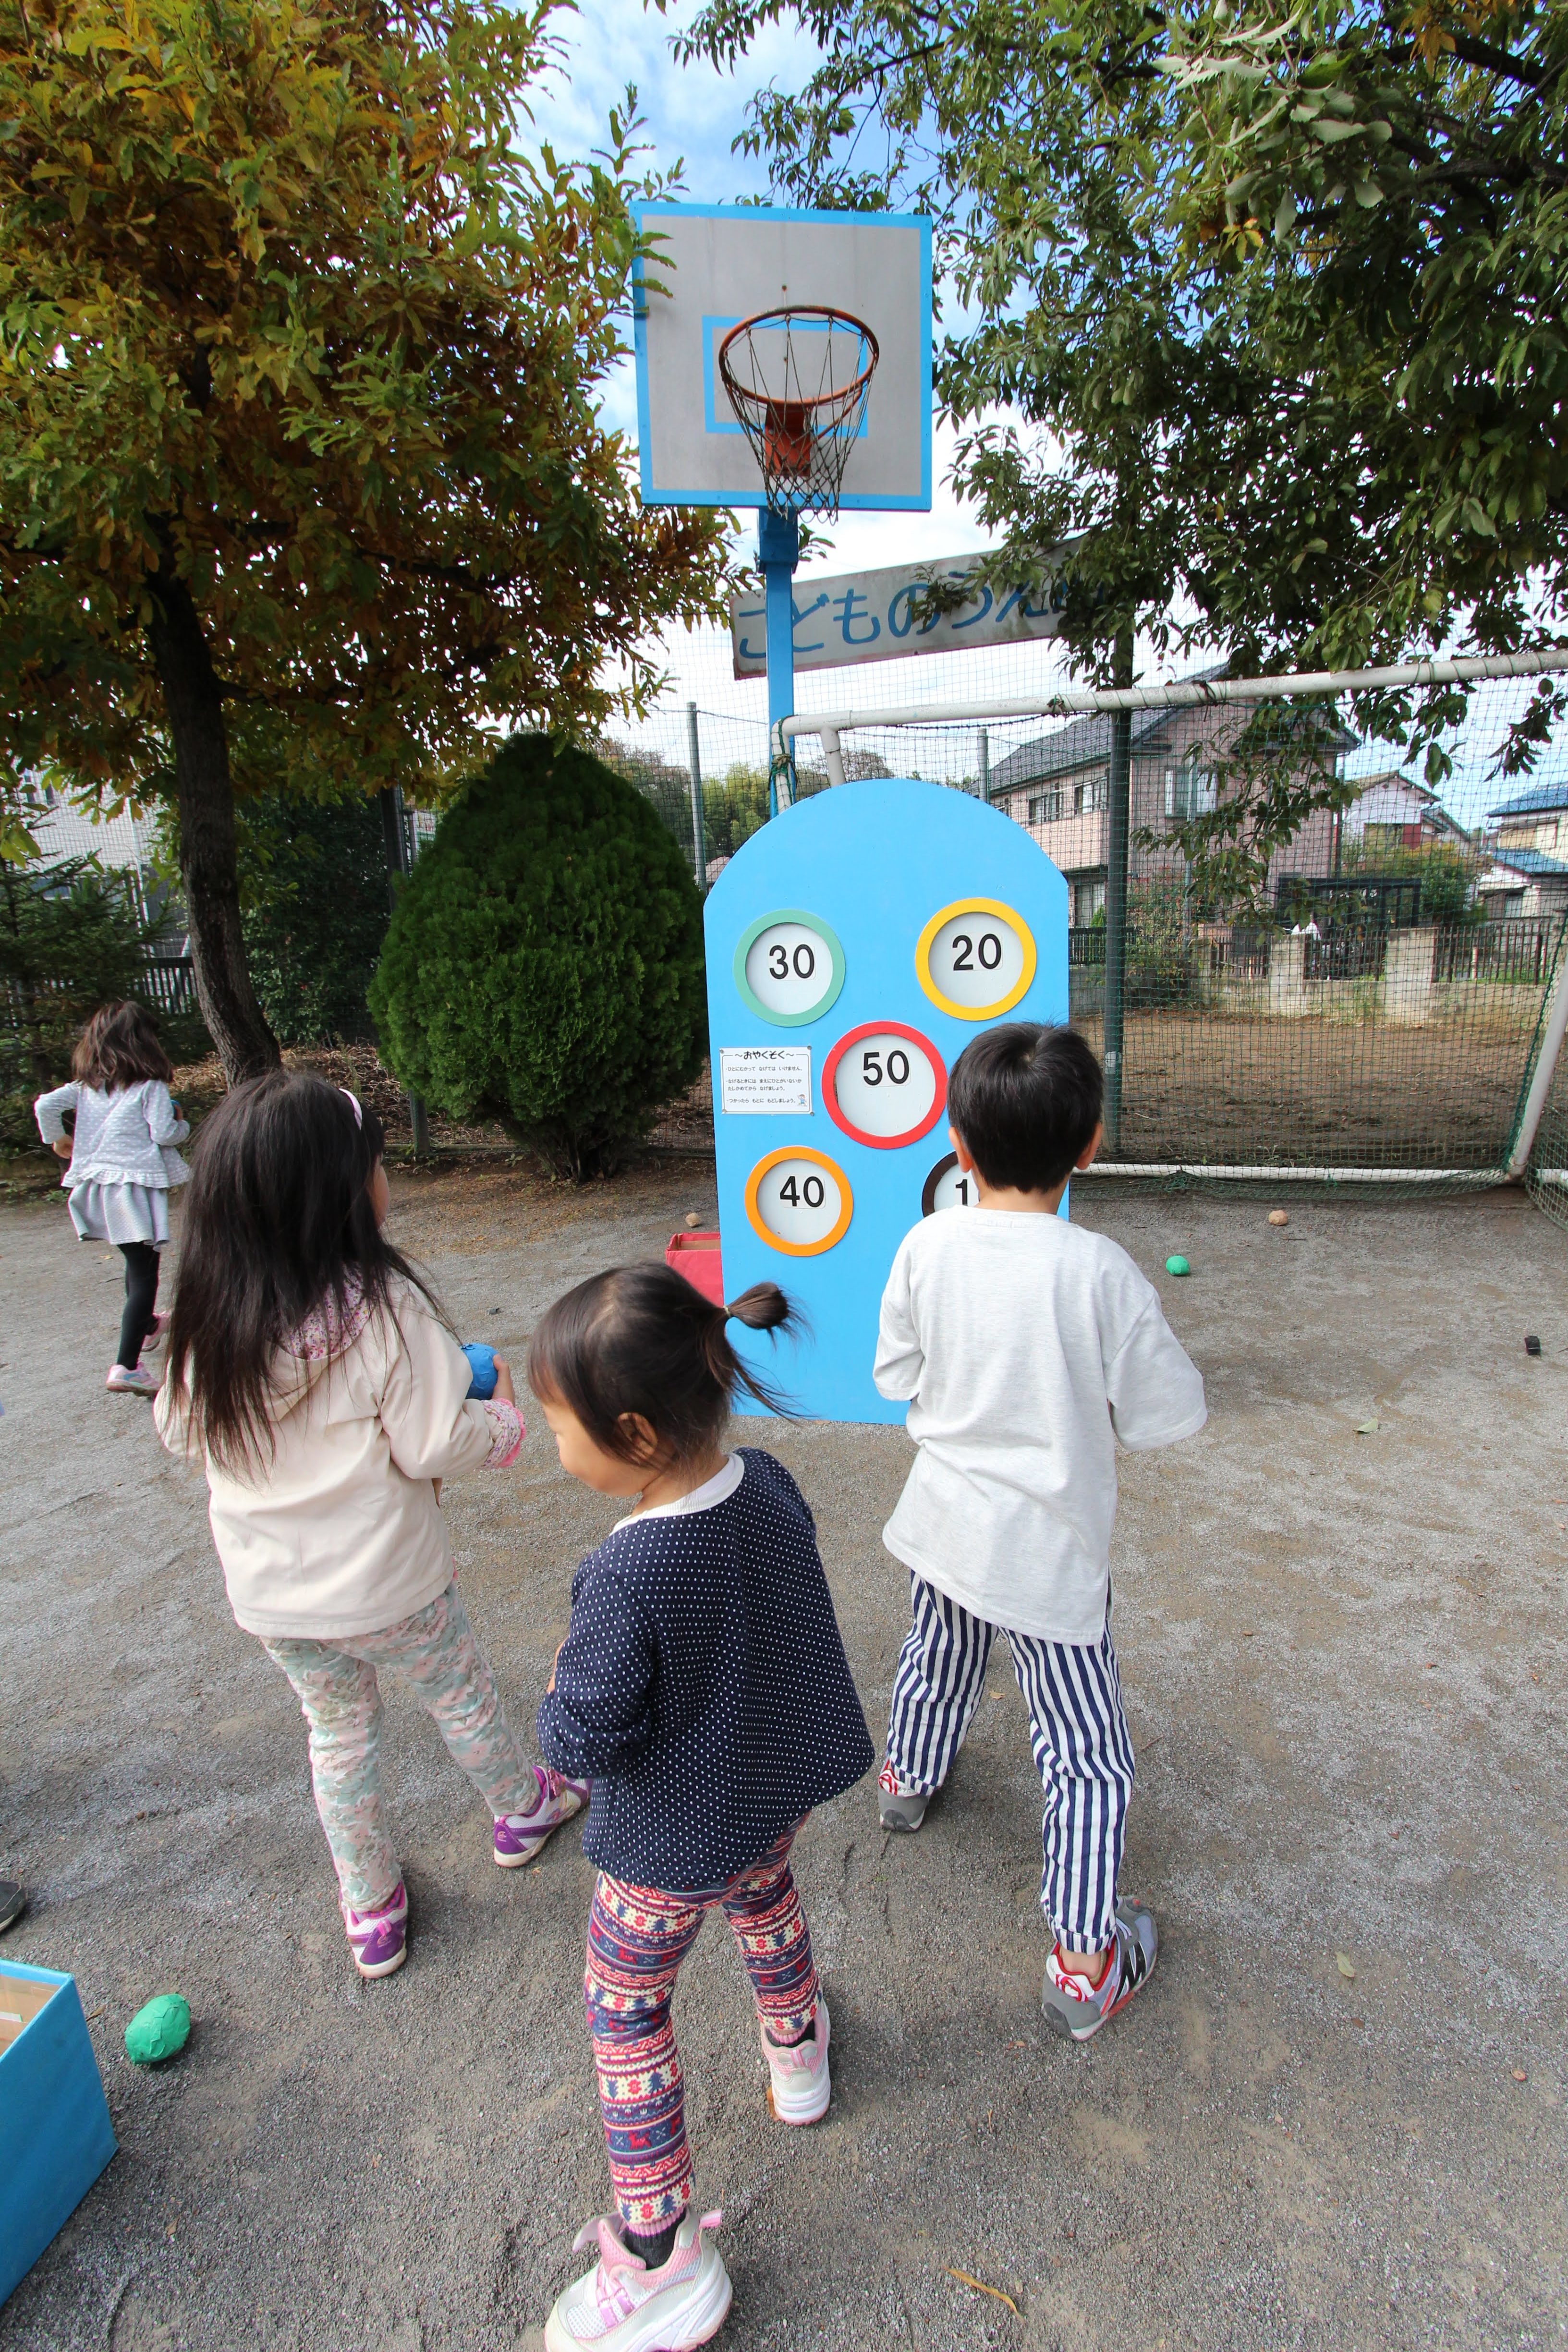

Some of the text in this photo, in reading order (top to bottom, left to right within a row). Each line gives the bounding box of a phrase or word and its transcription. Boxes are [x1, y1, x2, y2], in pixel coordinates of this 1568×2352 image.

[770, 945, 814, 979] 30
[953, 934, 1001, 970] 20
[863, 1051, 909, 1085] 50
[780, 1176, 824, 1207] 40
[956, 1179, 980, 1206] 1
